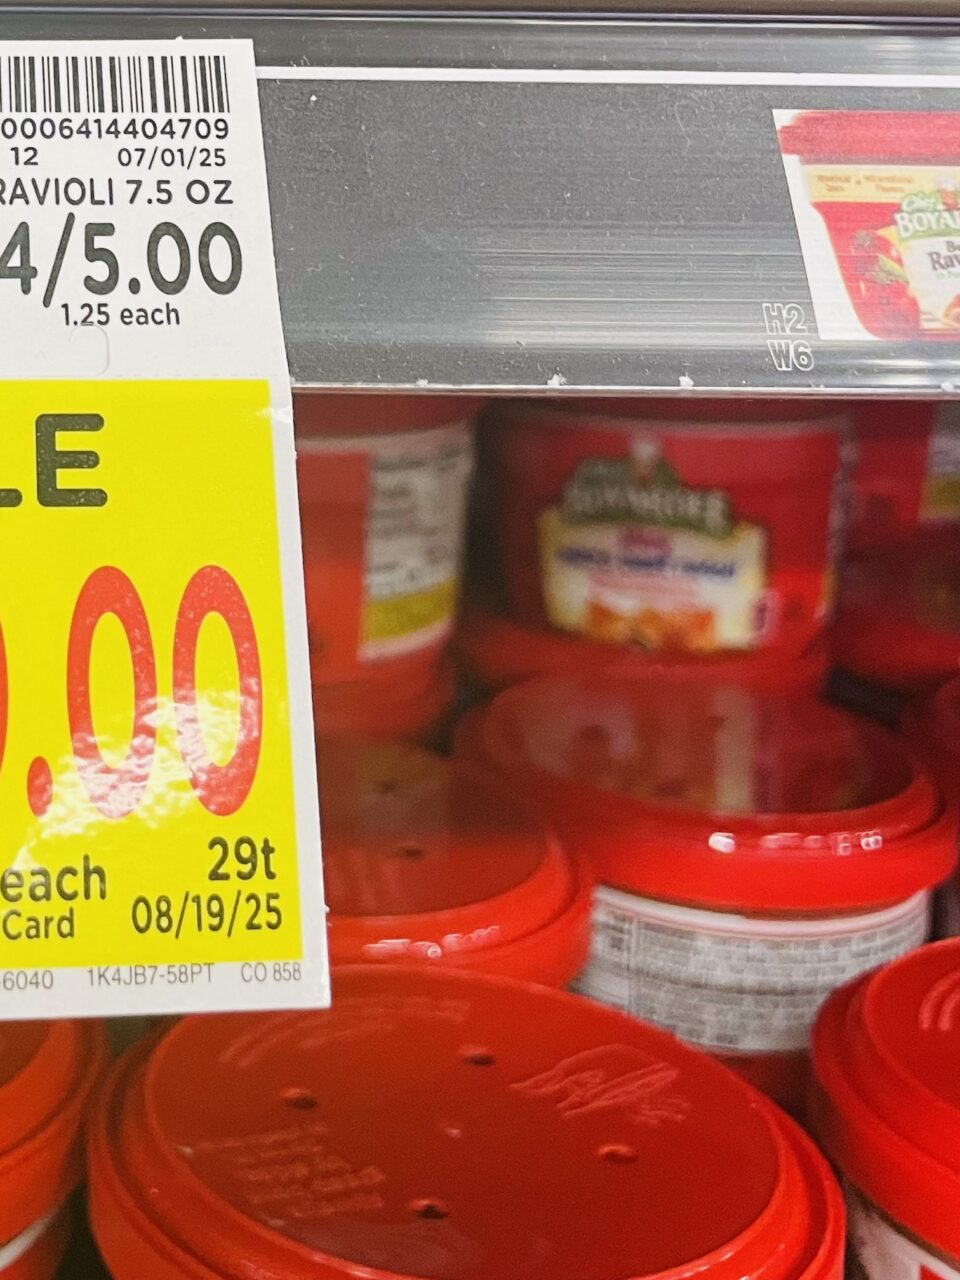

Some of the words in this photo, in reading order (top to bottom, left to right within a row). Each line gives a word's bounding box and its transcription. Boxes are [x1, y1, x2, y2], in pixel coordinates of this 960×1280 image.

[1, 118, 230, 140] 0006414404709
[10, 146, 39, 166] 12
[117, 146, 227, 170] 07/01/25
[126, 179, 173, 205] 7.5
[186, 179, 234, 205] OZ
[61, 302, 110, 326] 1.25
[120, 302, 180, 326] each
[762, 303, 807, 335] H2
[767, 339, 815, 371] W6
[208, 835, 277, 882] 29t
[0, 853, 107, 903] each
[2, 907, 75, 940] Card
[131, 889, 282, 939] 08/19/25
[87, 962, 215, 987] 1K4JB7-58PT
[241, 962, 268, 983] CO
[273, 962, 302, 983] 858
